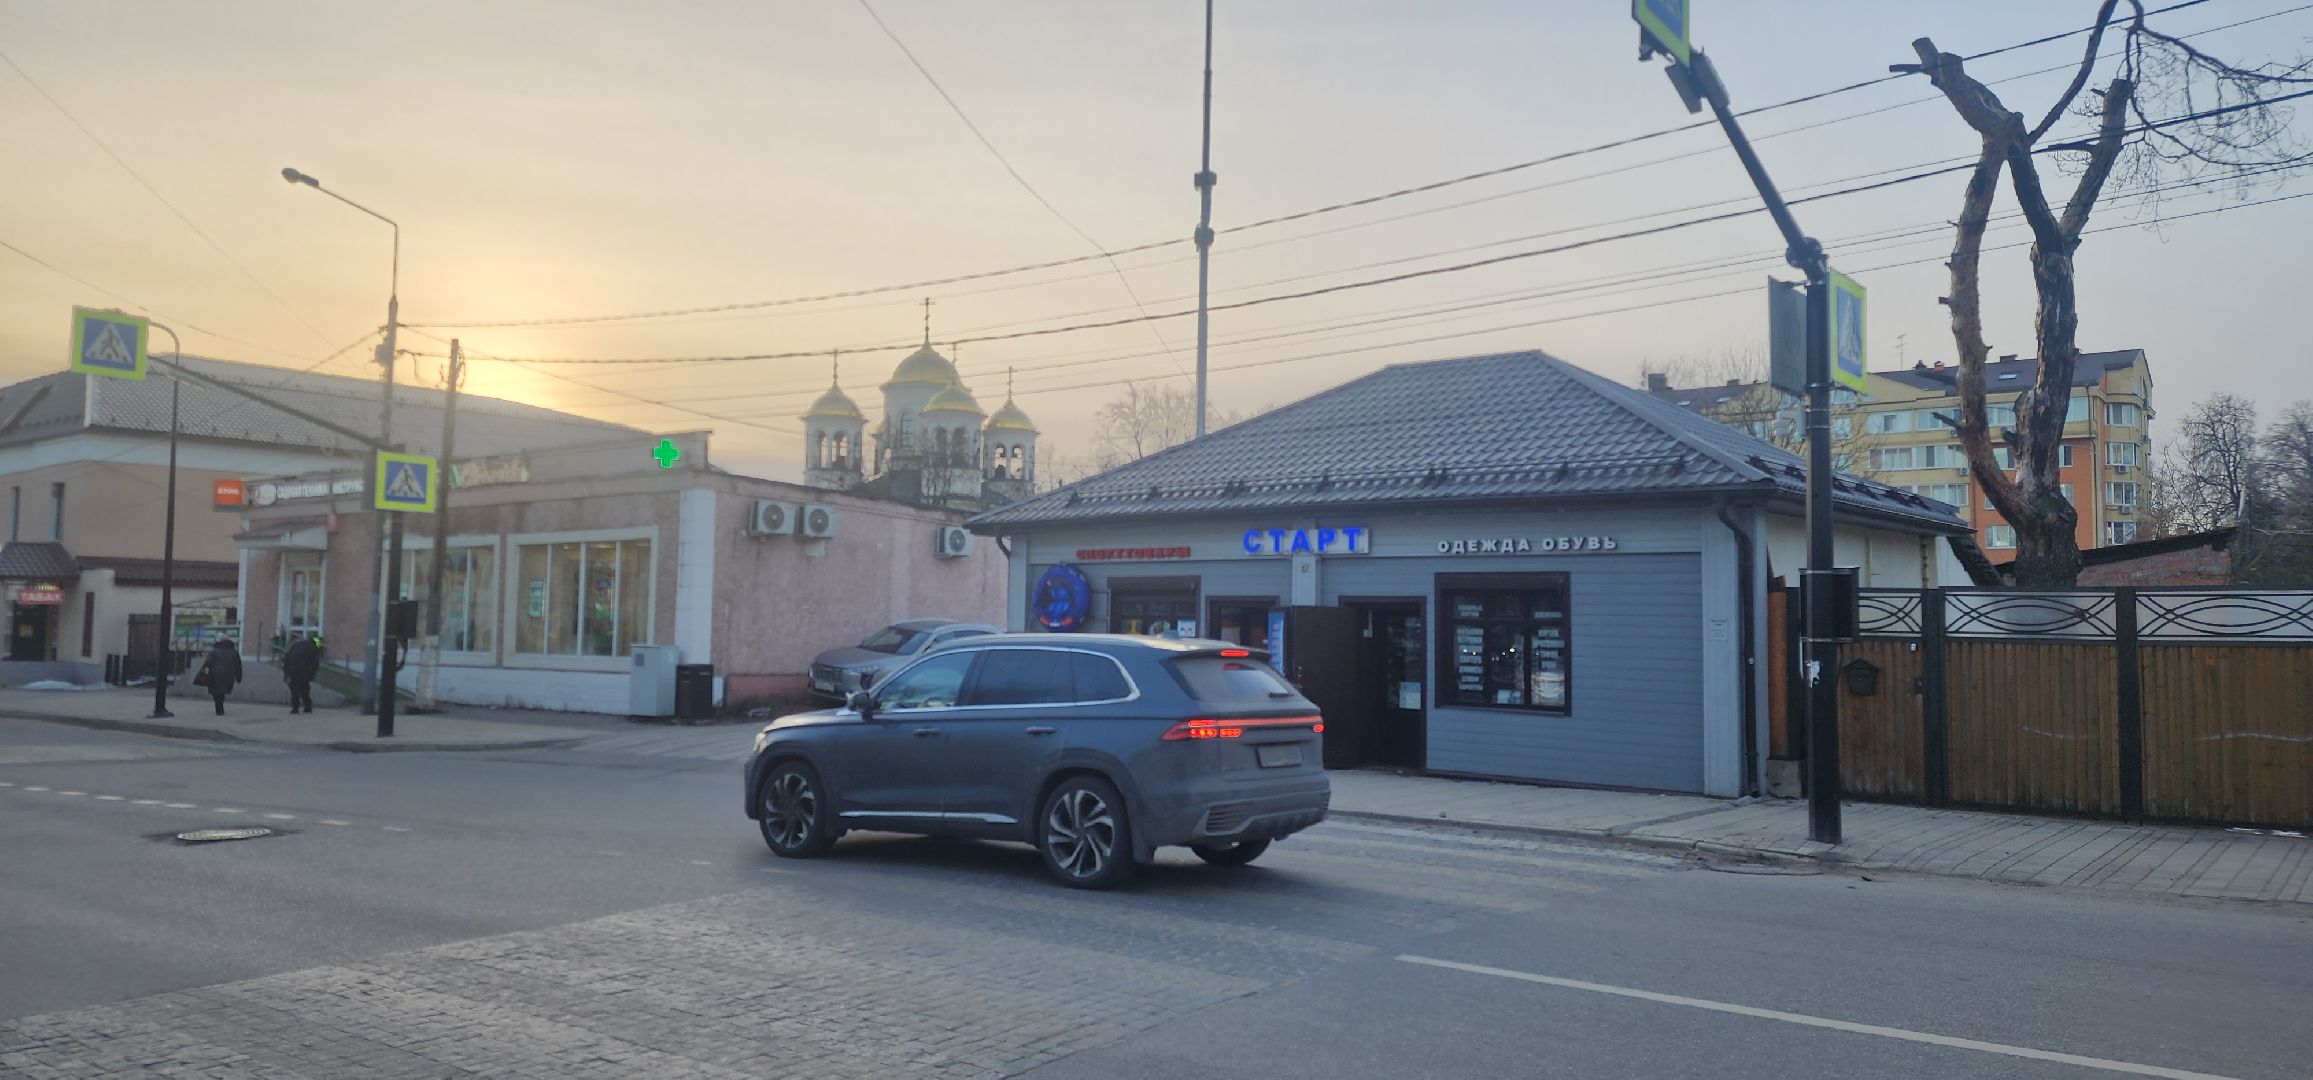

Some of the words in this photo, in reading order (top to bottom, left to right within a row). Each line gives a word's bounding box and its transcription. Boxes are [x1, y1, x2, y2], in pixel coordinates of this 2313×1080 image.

[1243, 527, 1362, 554] СТАРТ
[1437, 538, 1531, 554] ОДЕЖДА
[1542, 536, 1617, 551] ОБУВЬ
